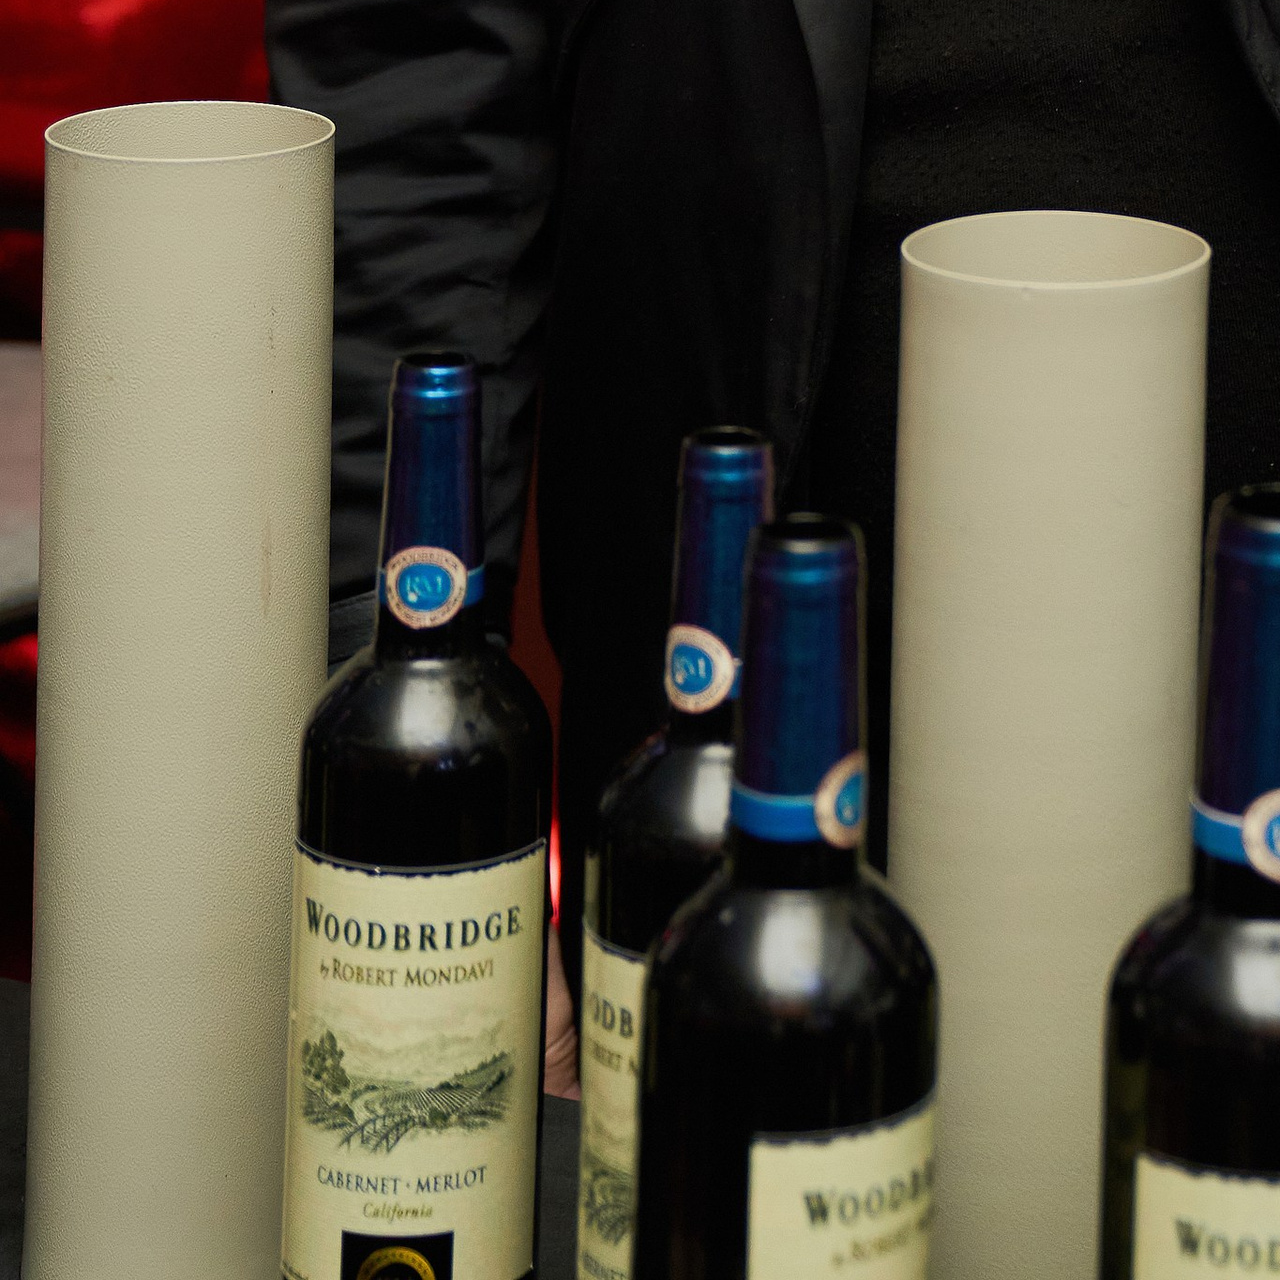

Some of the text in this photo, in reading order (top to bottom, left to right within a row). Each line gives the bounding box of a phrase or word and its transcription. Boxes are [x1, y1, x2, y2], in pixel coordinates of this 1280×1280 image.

[306, 896, 523, 952] WOODBRIDGE
[331, 958, 399, 988] ROBERT
[403, 957, 495, 988] MONDAVI
[317, 1164, 488, 1196] CABERNET MERLOT
[362, 1201, 434, 1224] California
